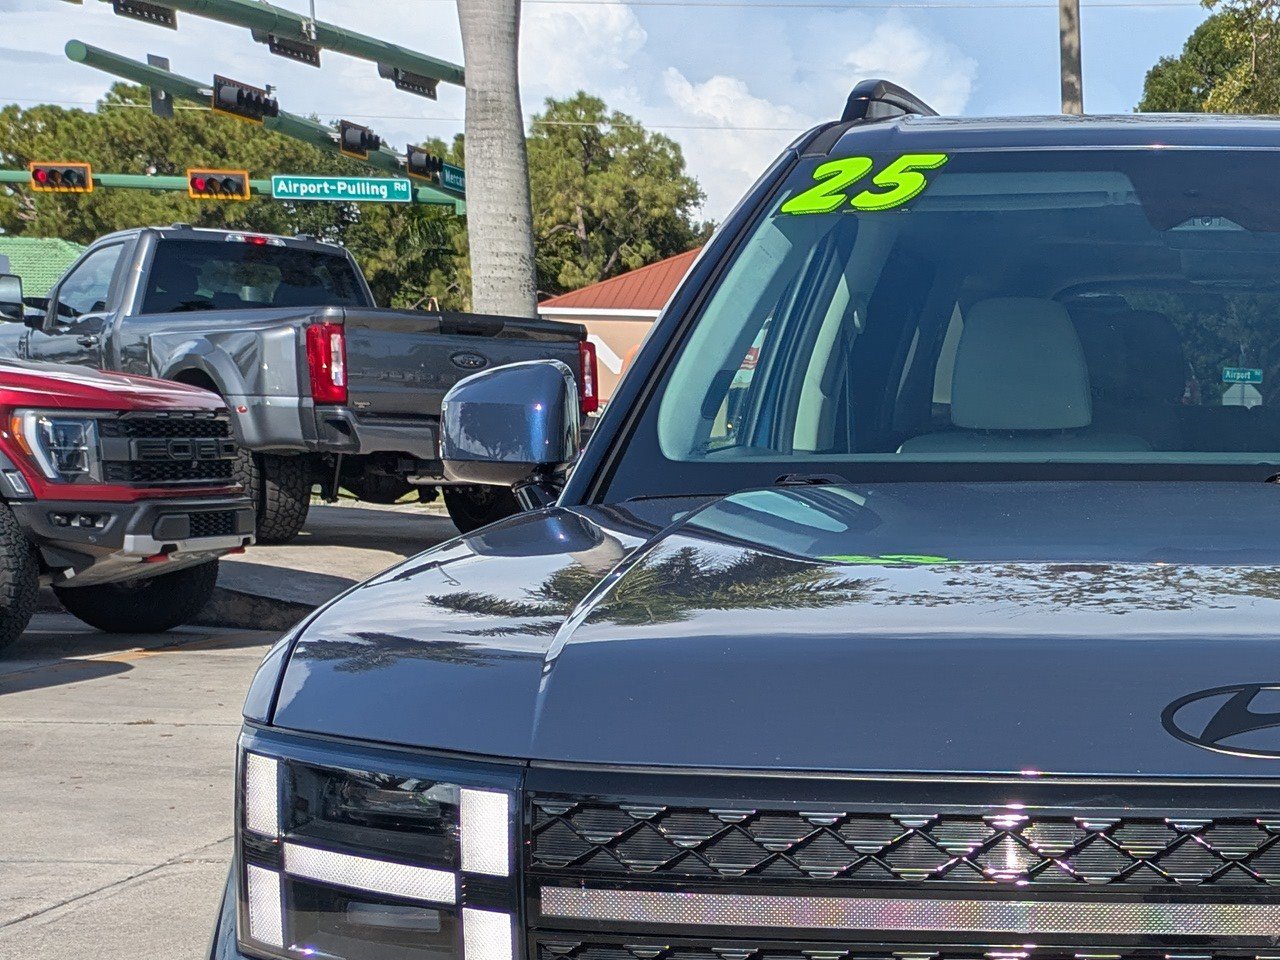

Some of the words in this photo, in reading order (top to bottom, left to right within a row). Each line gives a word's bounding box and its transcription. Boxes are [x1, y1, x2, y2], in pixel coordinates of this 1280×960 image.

[277, 180, 388, 198] Airport-Pulling
[394, 182, 407, 192] Rd
[781, 154, 948, 215] 25
[1225, 370, 1251, 380] Airport
